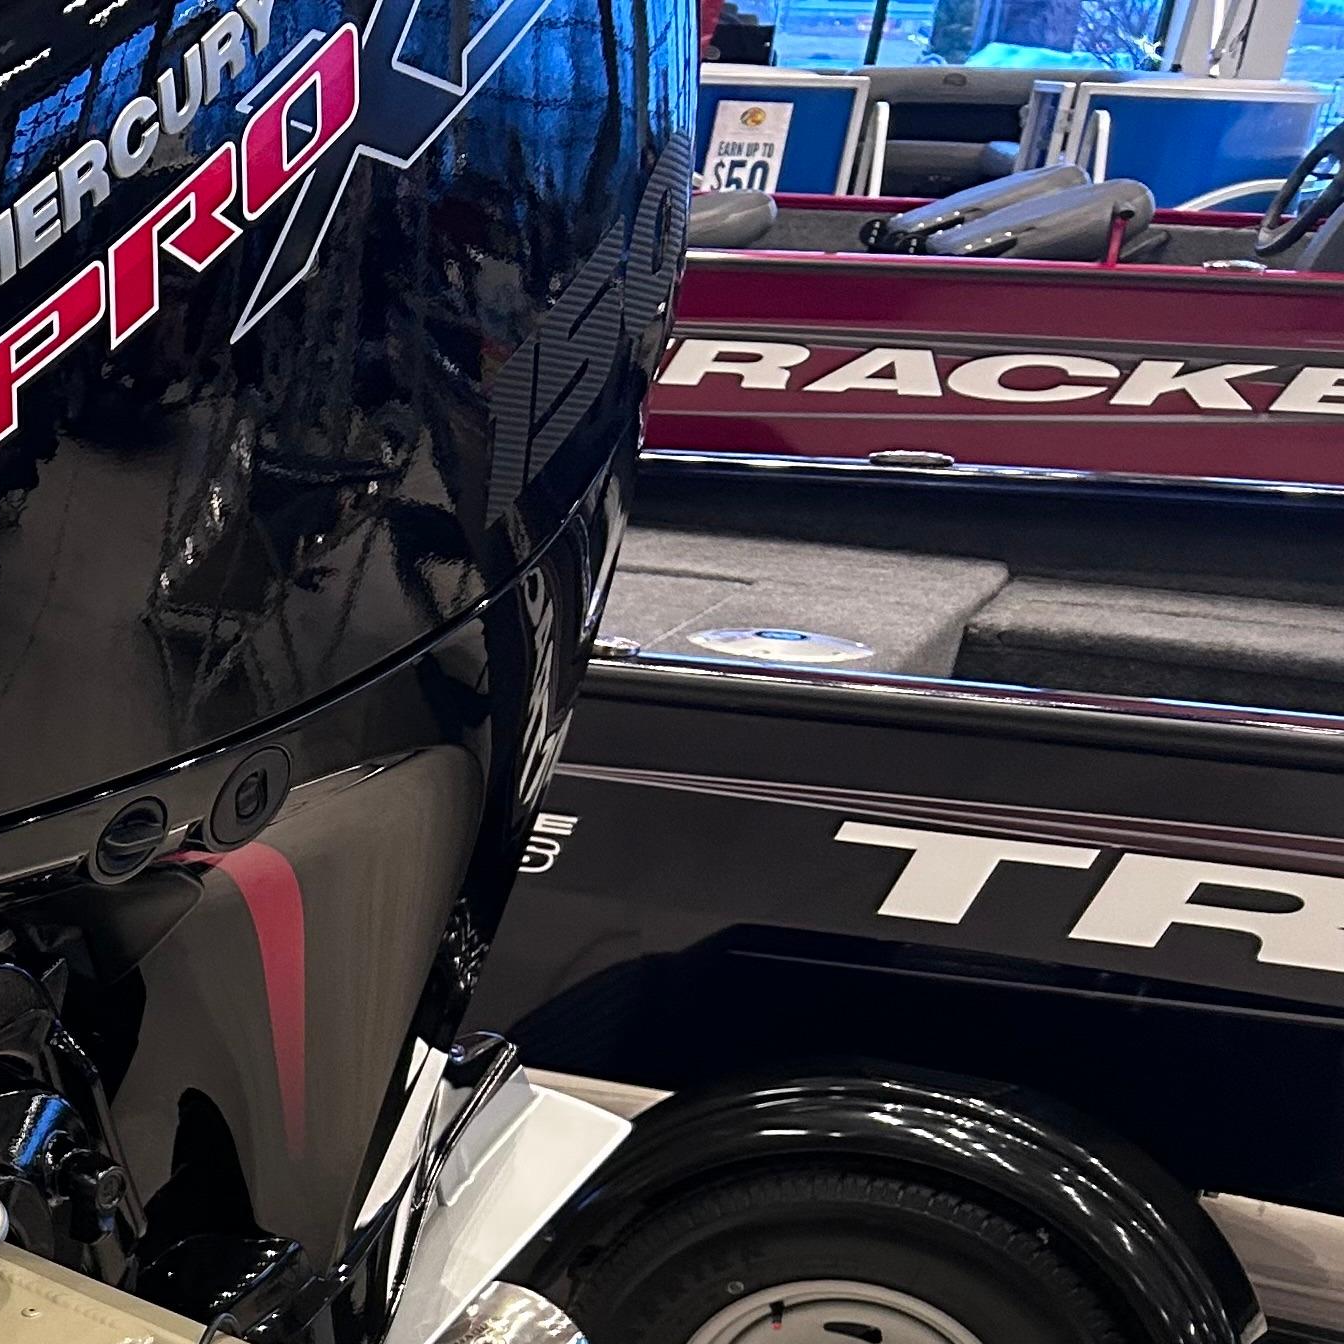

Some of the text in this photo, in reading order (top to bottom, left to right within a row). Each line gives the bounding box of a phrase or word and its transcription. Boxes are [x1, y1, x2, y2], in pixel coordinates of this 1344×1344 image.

[711, 160, 771, 190] $50
[717, 142, 776, 158] EARN UP TO
[653, 337, 1344, 415] RACKE
[833, 820, 1344, 973] TR
